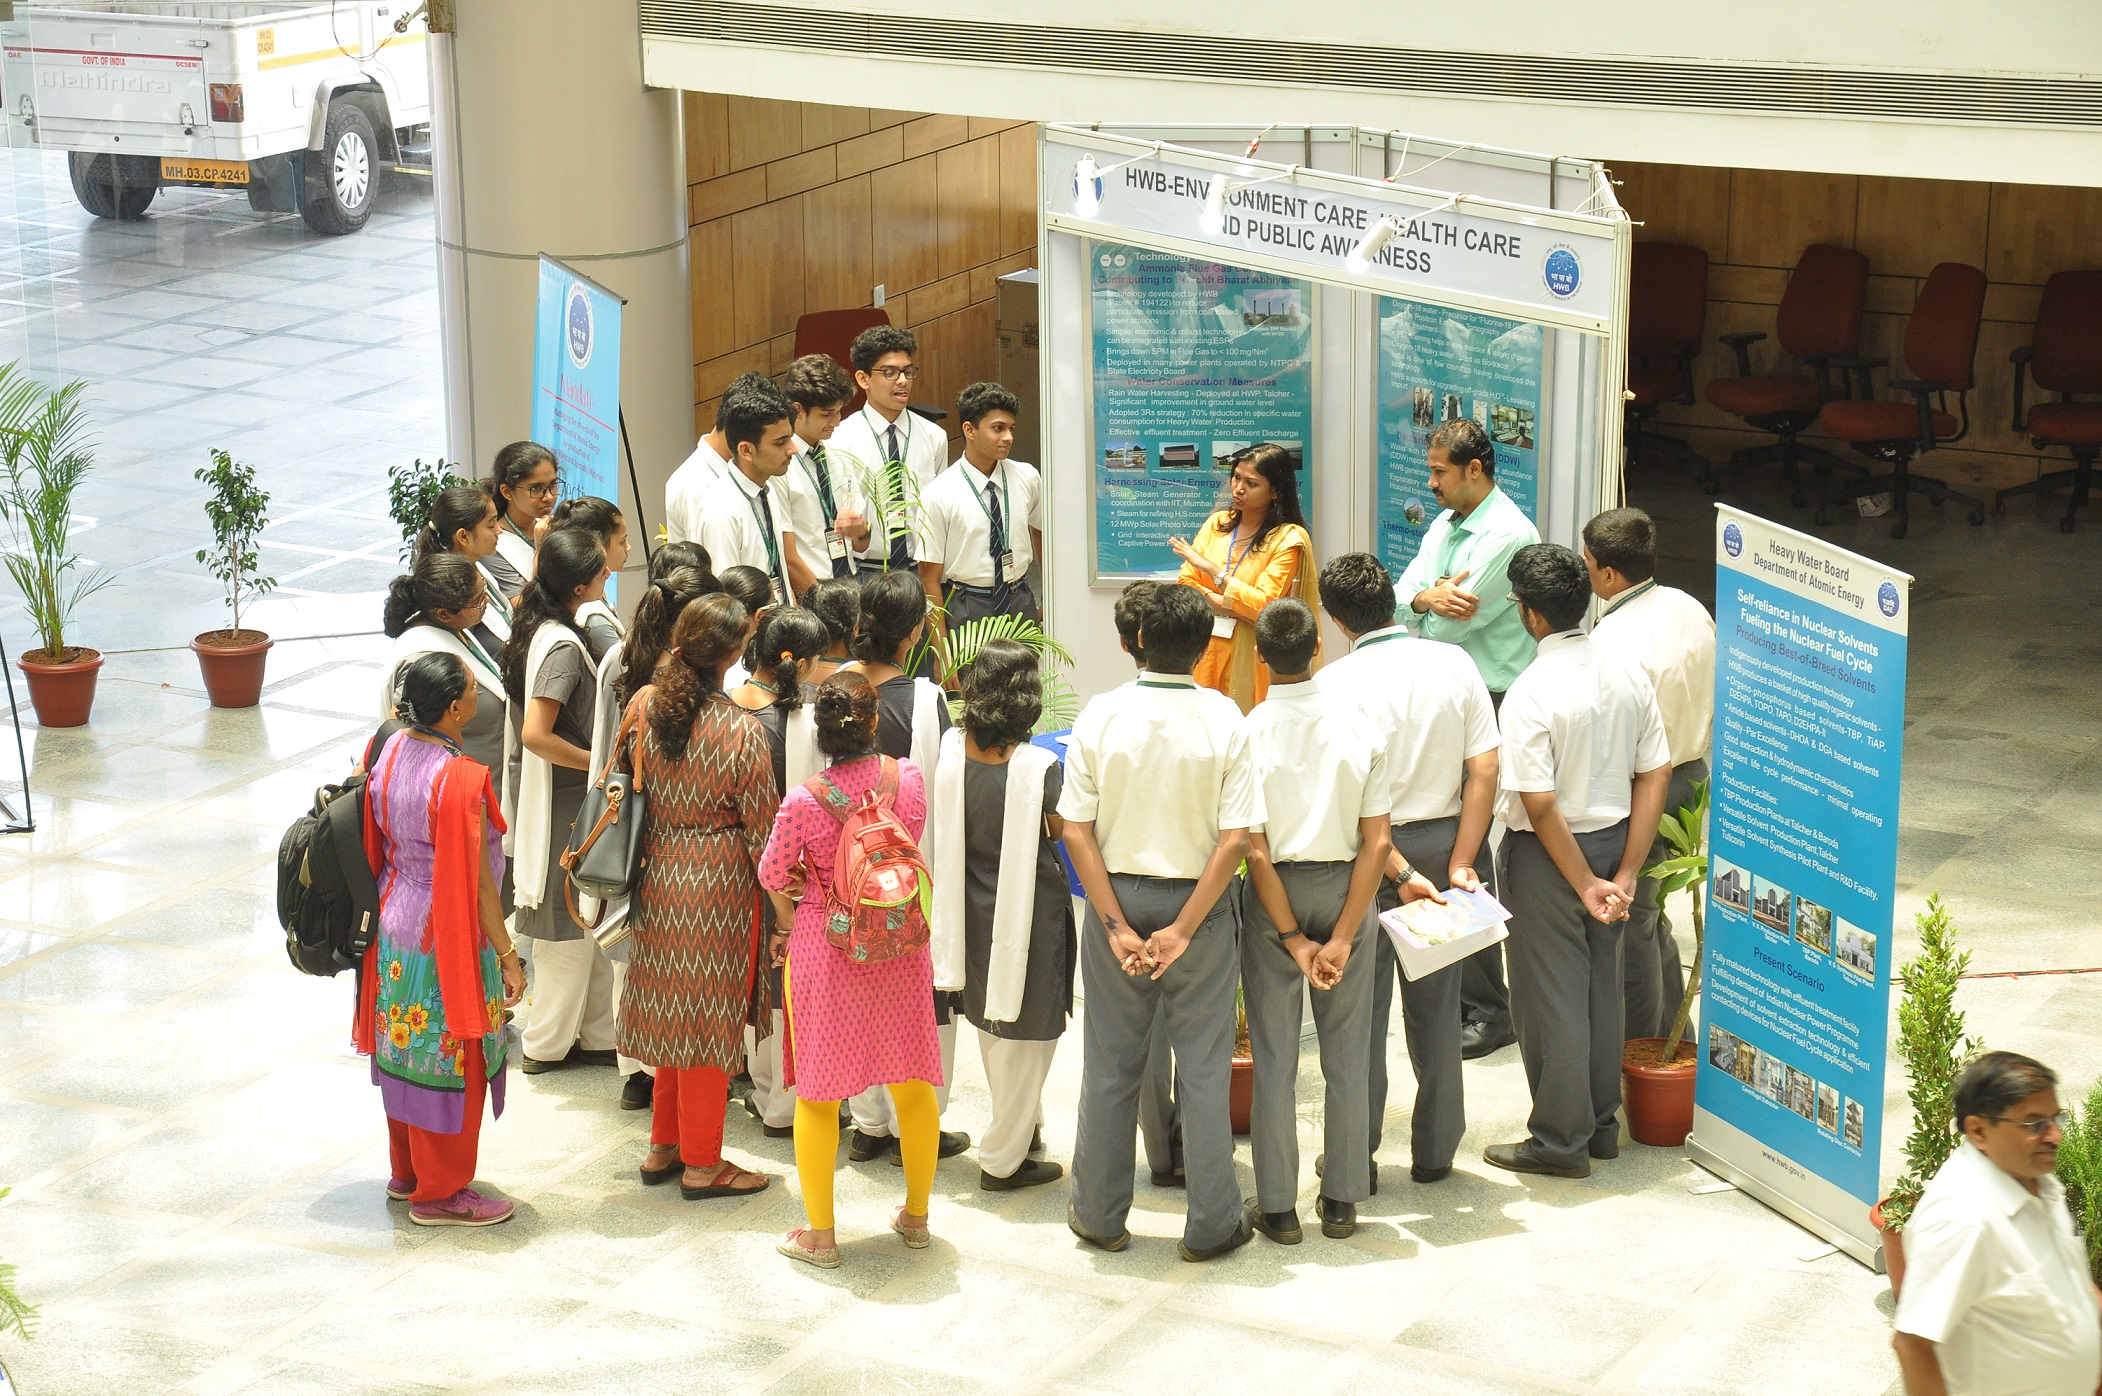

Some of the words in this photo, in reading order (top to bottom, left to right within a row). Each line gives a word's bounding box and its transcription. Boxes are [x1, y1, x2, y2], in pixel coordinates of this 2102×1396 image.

[82, 56, 99, 65] GOVT.
[101, 57, 109, 65] OF
[110, 57, 126, 66] INDIA
[166, 166, 246, 181] MH.03.CP.4241
[1126, 167, 1308, 219] HWB-ENVONMENT
[1464, 229, 1521, 259] CARE
[1248, 219, 1315, 251] PUBLIC
[1213, 264, 1231, 273] Gas
[1163, 276, 1172, 284] to
[1218, 275, 1250, 284] Bharat
[1553, 282, 1570, 292] HWB
[1107, 359, 1140, 368] Deployed
[1152, 360, 1175, 368] many
[1200, 359, 1222, 367] plants
[1224, 359, 1256, 368] operated
[1259, 359, 1268, 368] by
[1108, 367, 1127, 375] State
[1128, 367, 1162, 376] Electricity
[1159, 377, 1225, 386] Conservation
[1229, 378, 1277, 387] Measures
[1494, 373, 1523, 385] developed
[1525, 378, 1535, 386] this
[1109, 389, 1125, 397] Rain
[1127, 389, 1148, 397] Water
[1151, 389, 1189, 398] Harvesting
[1196, 390, 1231, 398] Deployed
[1109, 398, 1146, 407] Significant
[1151, 398, 1198, 407] improvement
[1208, 399, 1234, 407] ground
[1109, 409, 1139, 417] Adopted
[1156, 410, 1185, 418] strategy
[1210, 409, 1242, 417] reduction
[1253, 409, 1280, 419] specific
[1109, 418, 1156, 427] consumption
[1167, 418, 1192, 427] Heavy
[1192, 418, 1212, 426] Water
[1216, 418, 1254, 426] Production
[1109, 428, 1140, 436] Effective
[1144, 428, 1171, 436] effluent
[1173, 428, 1207, 436] treatment
[1233, 429, 1260, 437] Effluent
[1262, 429, 1299, 438] Discharge
[1502, 469, 1532, 481] abundance
[1770, 539, 1795, 564] Heavy
[1797, 549, 1822, 571] Water
[1825, 560, 1849, 581] Board
[1754, 553, 1797, 581] Department
[1799, 572, 1807, 584] of
[1809, 574, 1835, 595] Atomic
[1838, 585, 1864, 609] Energy
[1738, 589, 1790, 621] Self-reliance
[1792, 611, 1800, 625] in
[1802, 615, 1836, 640] Nuclear
[1838, 630, 1878, 657] Solvents
[1741, 608, 1771, 635] Fueling
[1773, 623, 1787, 638] the
[1790, 628, 1825, 652] Nuclear
[1826, 643, 1844, 662] Fuel
[1846, 652, 1873, 673] Cycle
[1736, 624, 1777, 655] Producing
[1779, 643, 1836, 677] Best-of-Breed
[1838, 668, 1876, 694] Solvents
[1761, 661, 1792, 680] developed
[1794, 704, 1816, 720] based
[1744, 711, 1763, 726] based
[1811, 739, 1816, 749] &
[1834, 750, 1851, 765] based
[1853, 761, 1879, 777] solvents
[1723, 759, 1733, 770] cost
[1763, 766, 1778, 778] cycle
[1781, 774, 1819, 796] performance
[1851, 807, 1882, 827] operating
[1747, 814, 1769, 831] Solvent
[1770, 825, 1801, 847] Production
[1754, 946, 1785, 973] Present
[1787, 964, 1824, 992] Scenario
[1711, 978, 1748, 1005] Development
[1756, 1004, 1777, 1020] solvent
[1778, 1016, 1806, 1036] extraction
[1808, 1030, 1840, 1055] technology
